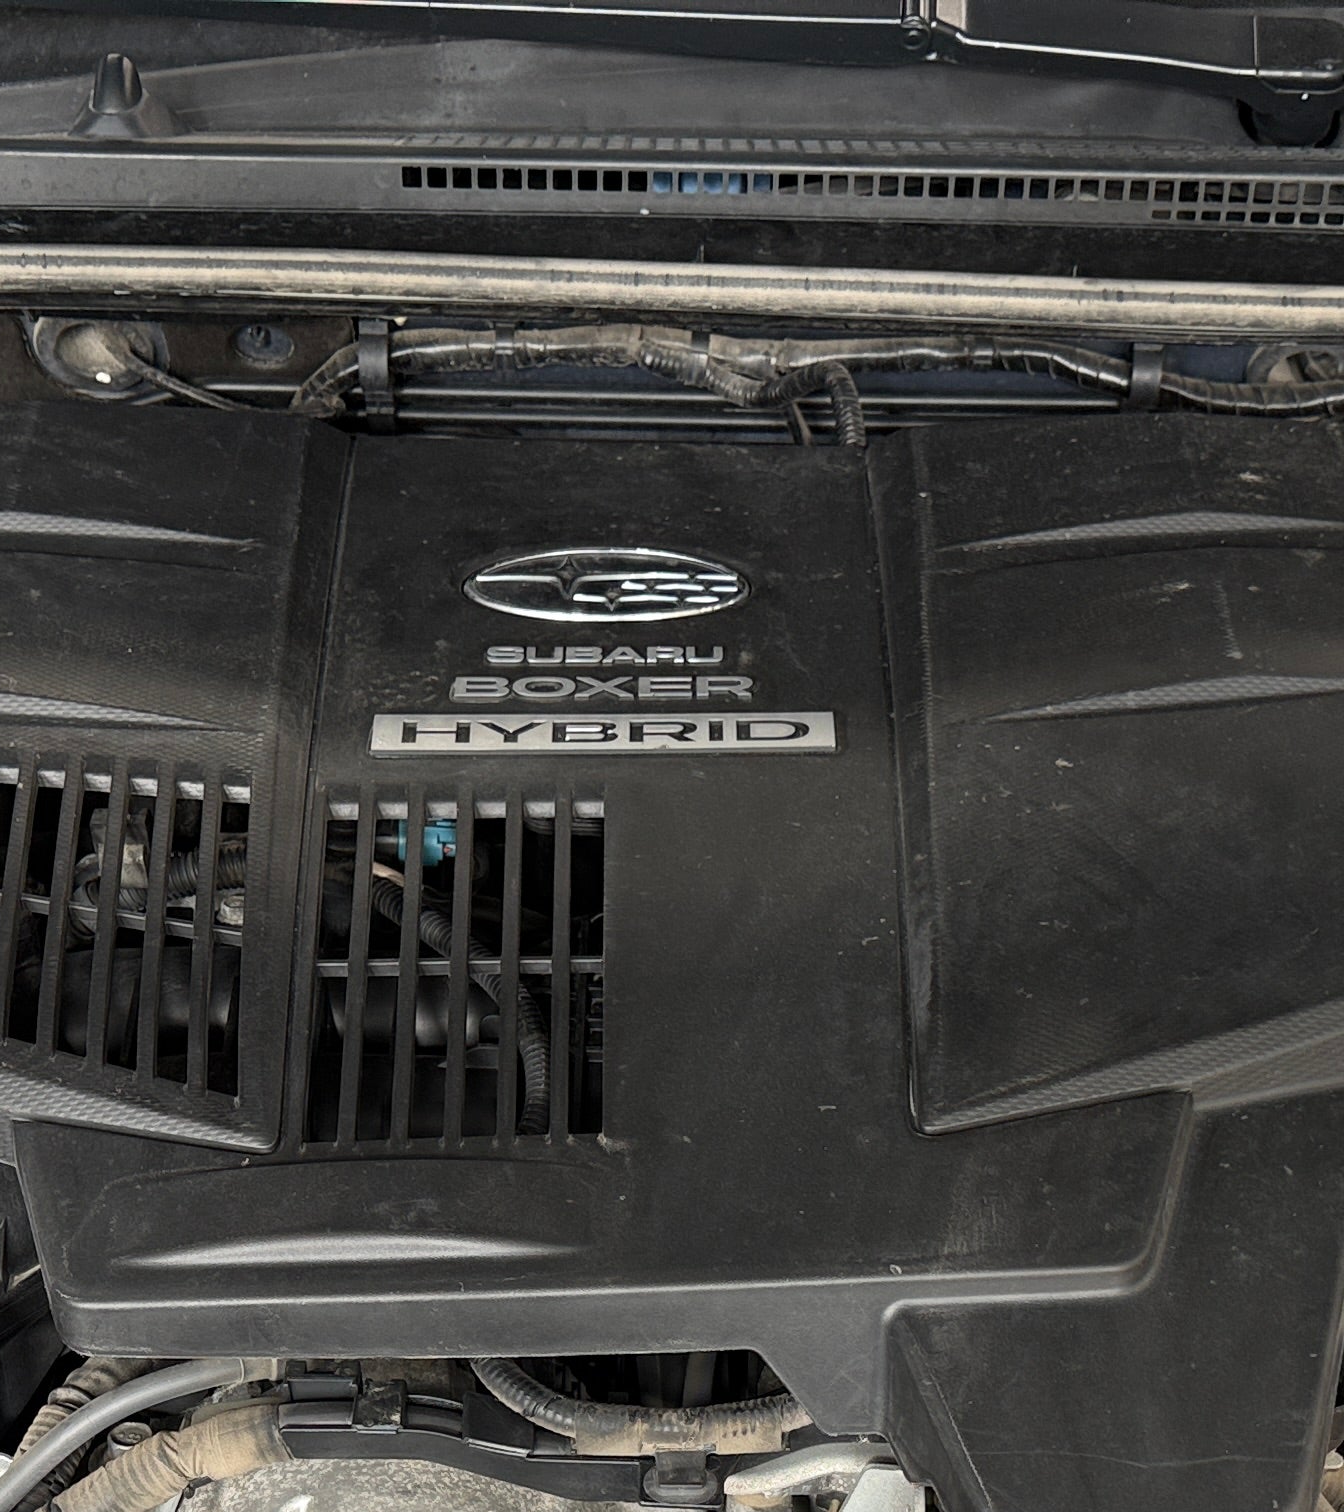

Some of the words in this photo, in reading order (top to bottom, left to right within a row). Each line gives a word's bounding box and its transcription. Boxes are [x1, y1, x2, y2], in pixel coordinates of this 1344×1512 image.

[485, 644, 724, 665] SUBARU
[449, 675, 756, 702] BOXER
[400, 719, 812, 744] HYBRID
